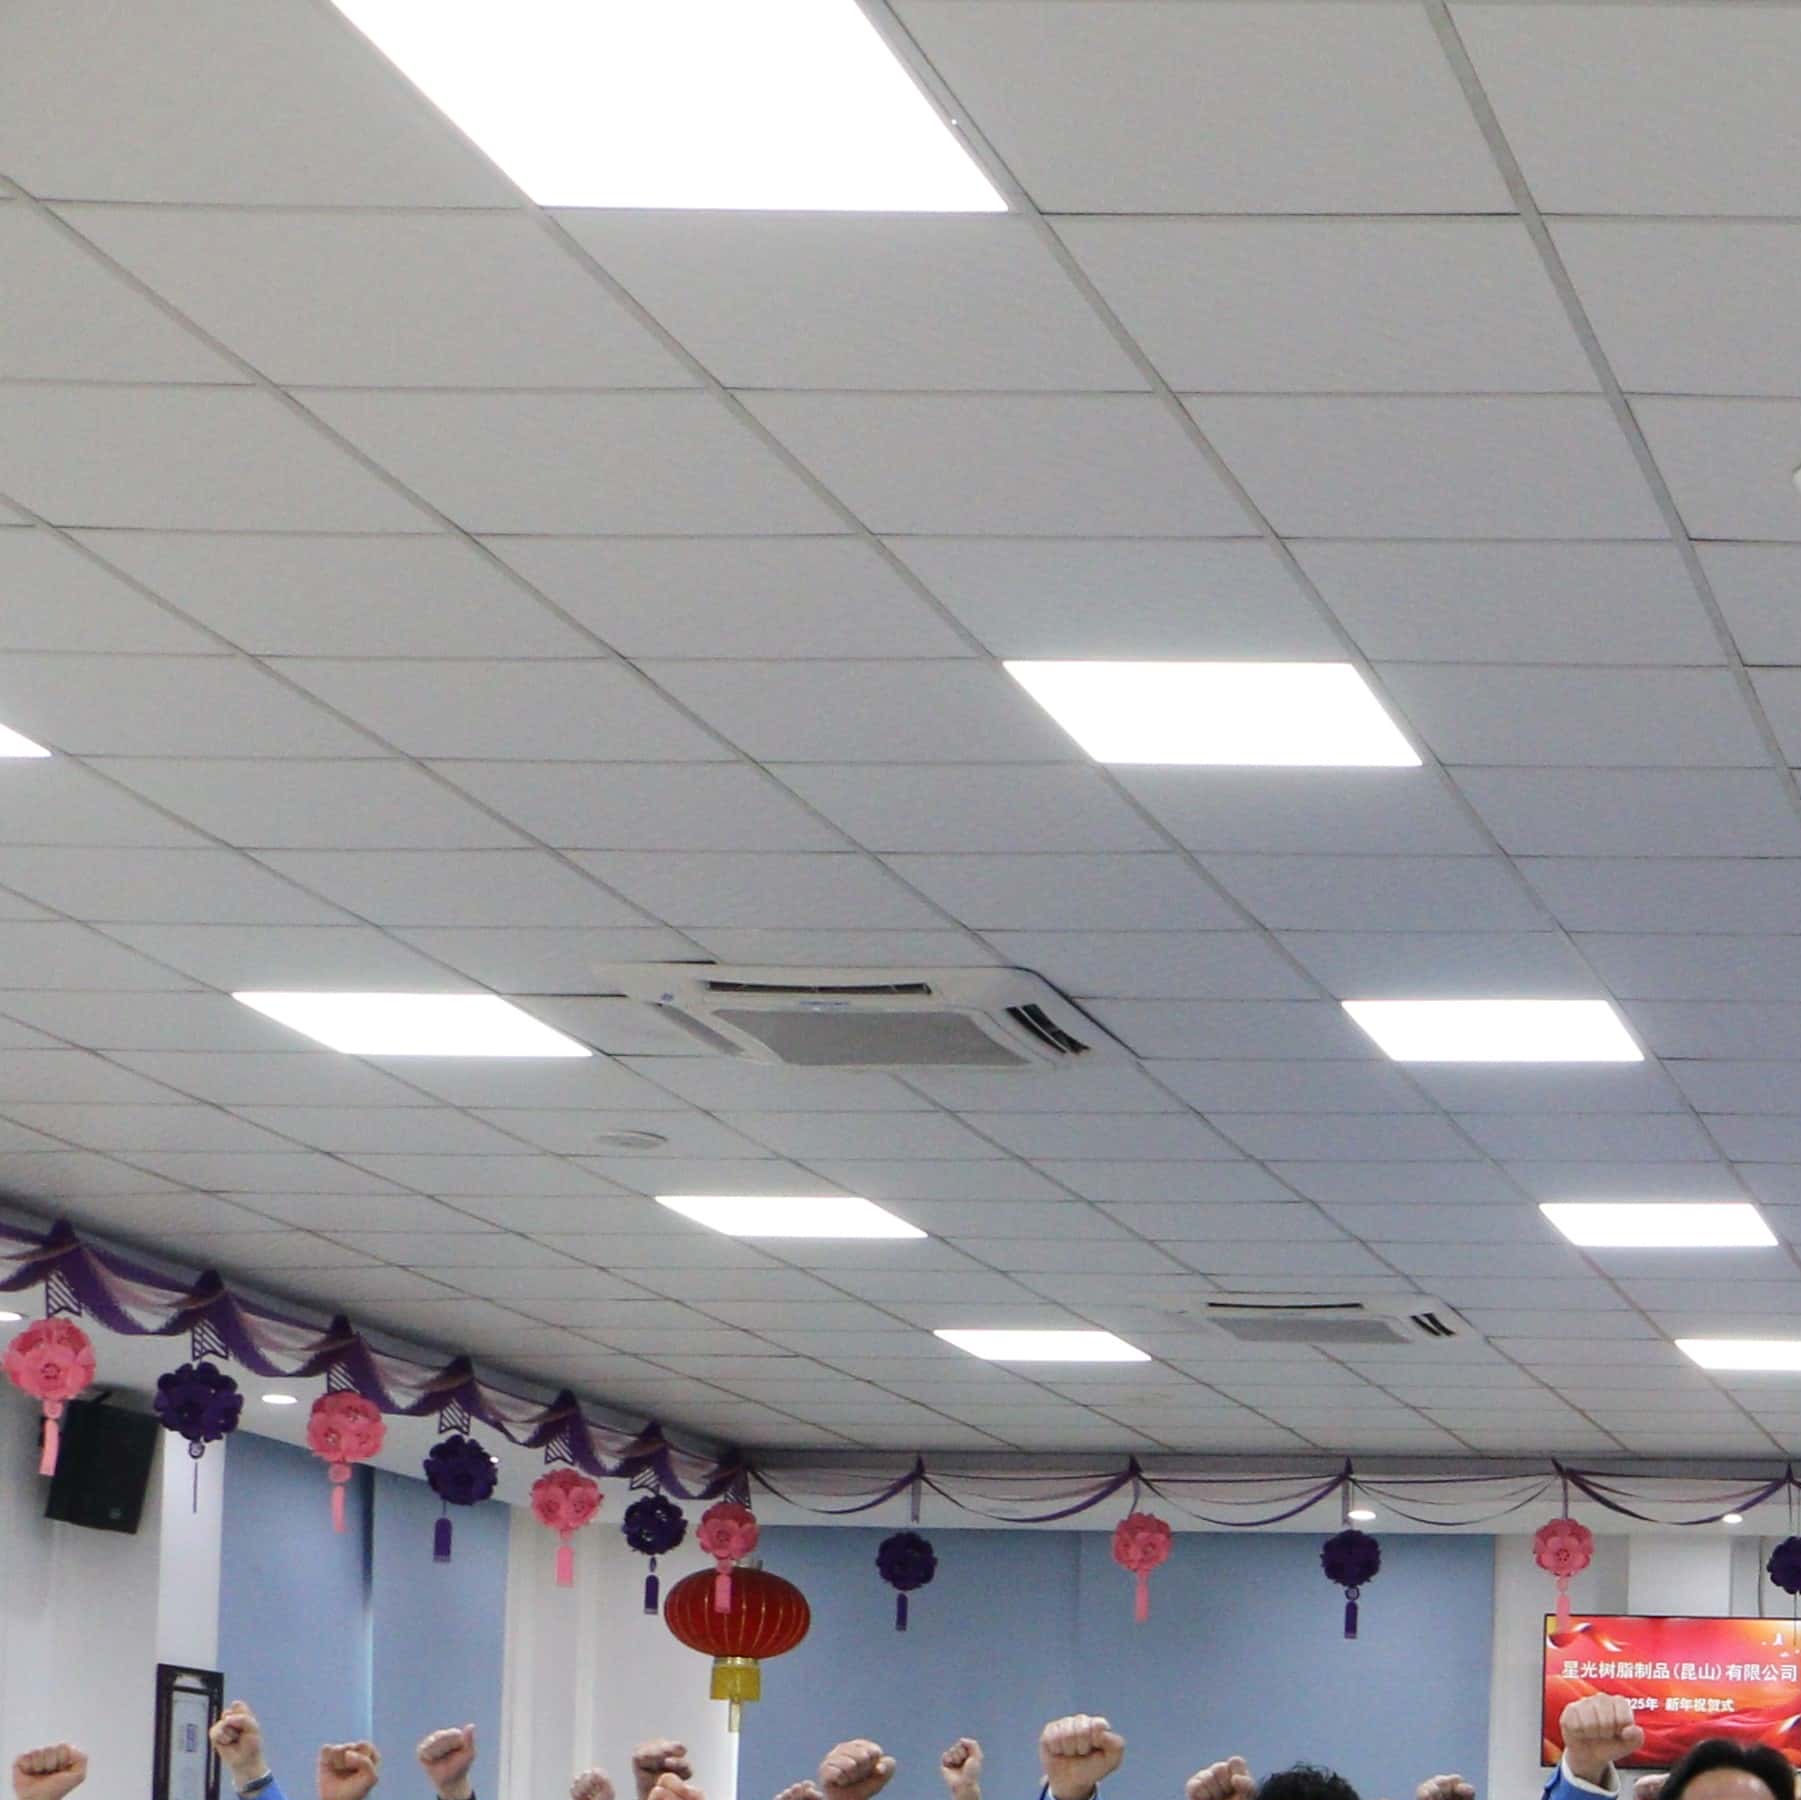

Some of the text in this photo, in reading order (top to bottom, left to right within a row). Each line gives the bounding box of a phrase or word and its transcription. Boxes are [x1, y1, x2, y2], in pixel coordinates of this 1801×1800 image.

[1627, 1697, 1735, 1713] 25年 新年祝贺式
